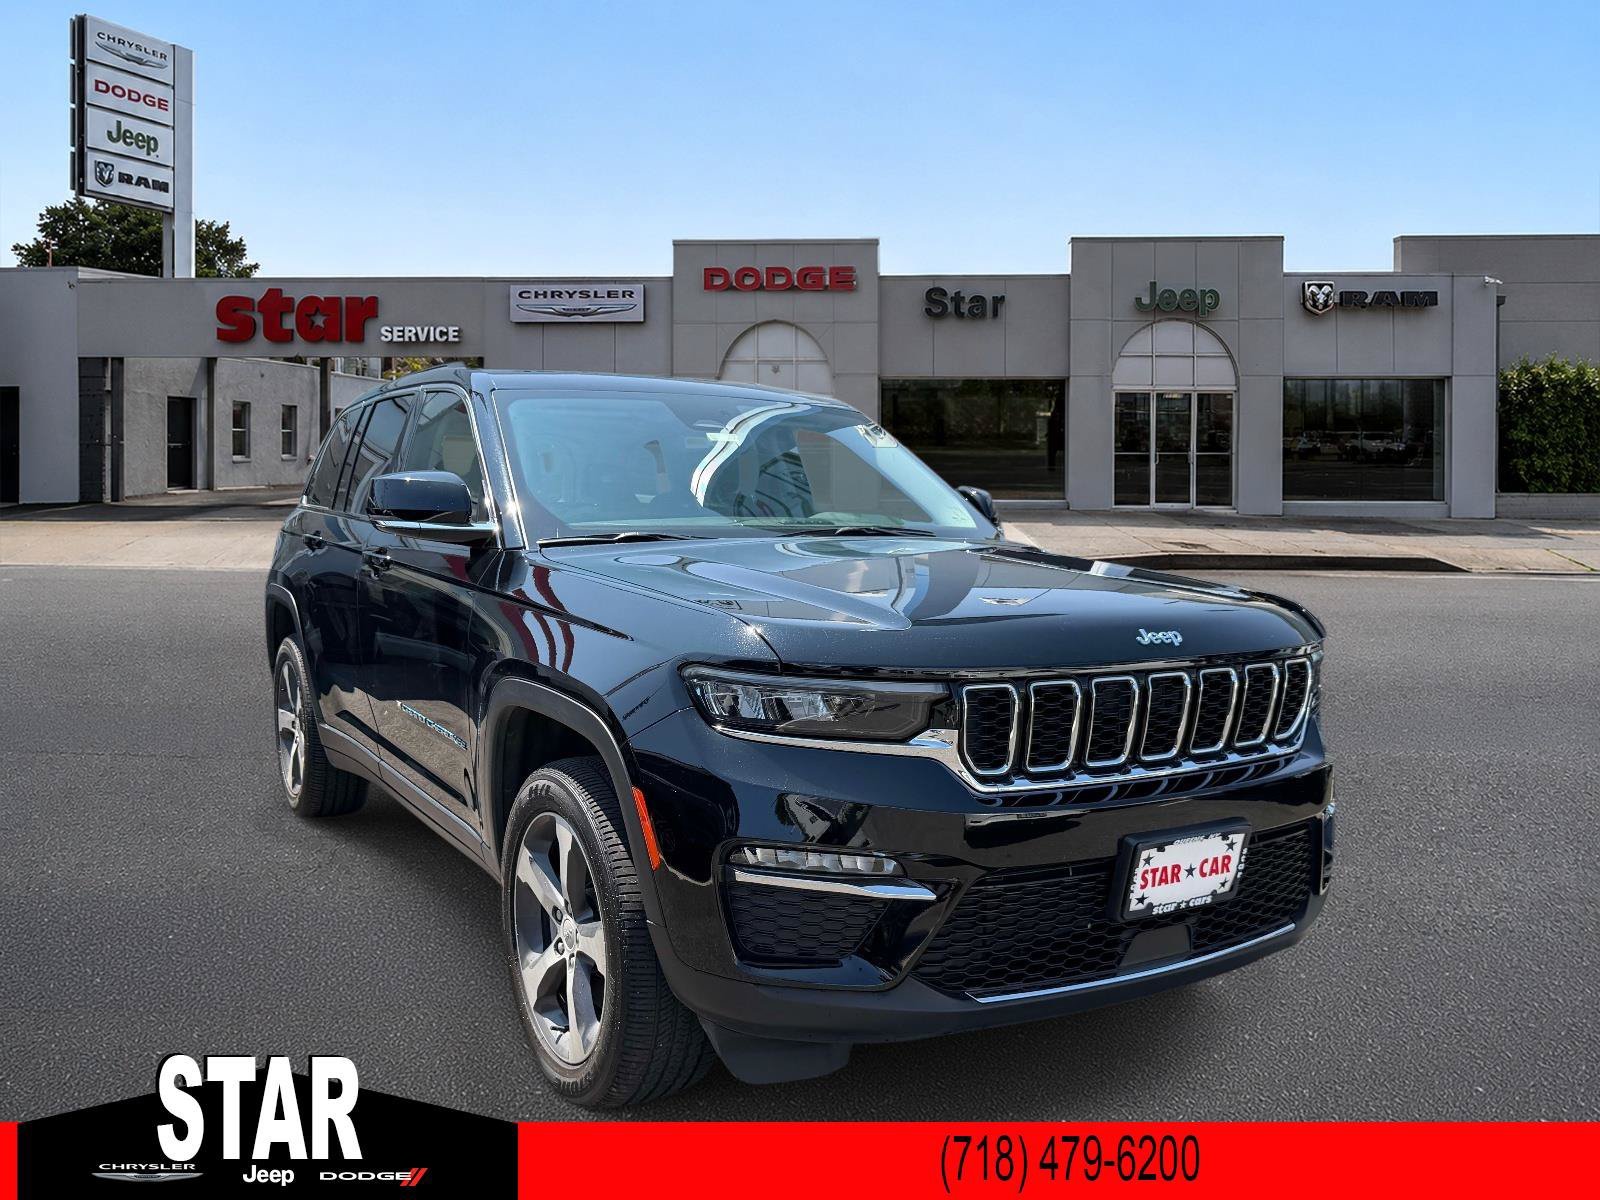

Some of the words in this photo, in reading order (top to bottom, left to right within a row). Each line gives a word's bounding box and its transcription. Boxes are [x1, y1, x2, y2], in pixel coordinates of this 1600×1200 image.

[97, 31, 168, 61] CHRYSLER
[94, 79, 169, 112] DODGE
[107, 120, 159, 156] Jeep
[118, 172, 169, 193] RAM
[703, 266, 857, 292] DODGE
[518, 290, 635, 299] CHRYSLER
[924, 286, 1006, 320] Star
[1134, 281, 1221, 317] Jeep
[1339, 290, 1439, 307] RAM
[216, 287, 379, 343] star
[380, 325, 461, 343] SERVICE
[1136, 628, 1183, 647] Jeep
[1139, 863, 1182, 890] STAR
[1199, 854, 1232, 878] CAR
[1152, 902, 1178, 915] star
[1189, 895, 1213, 907] cars
